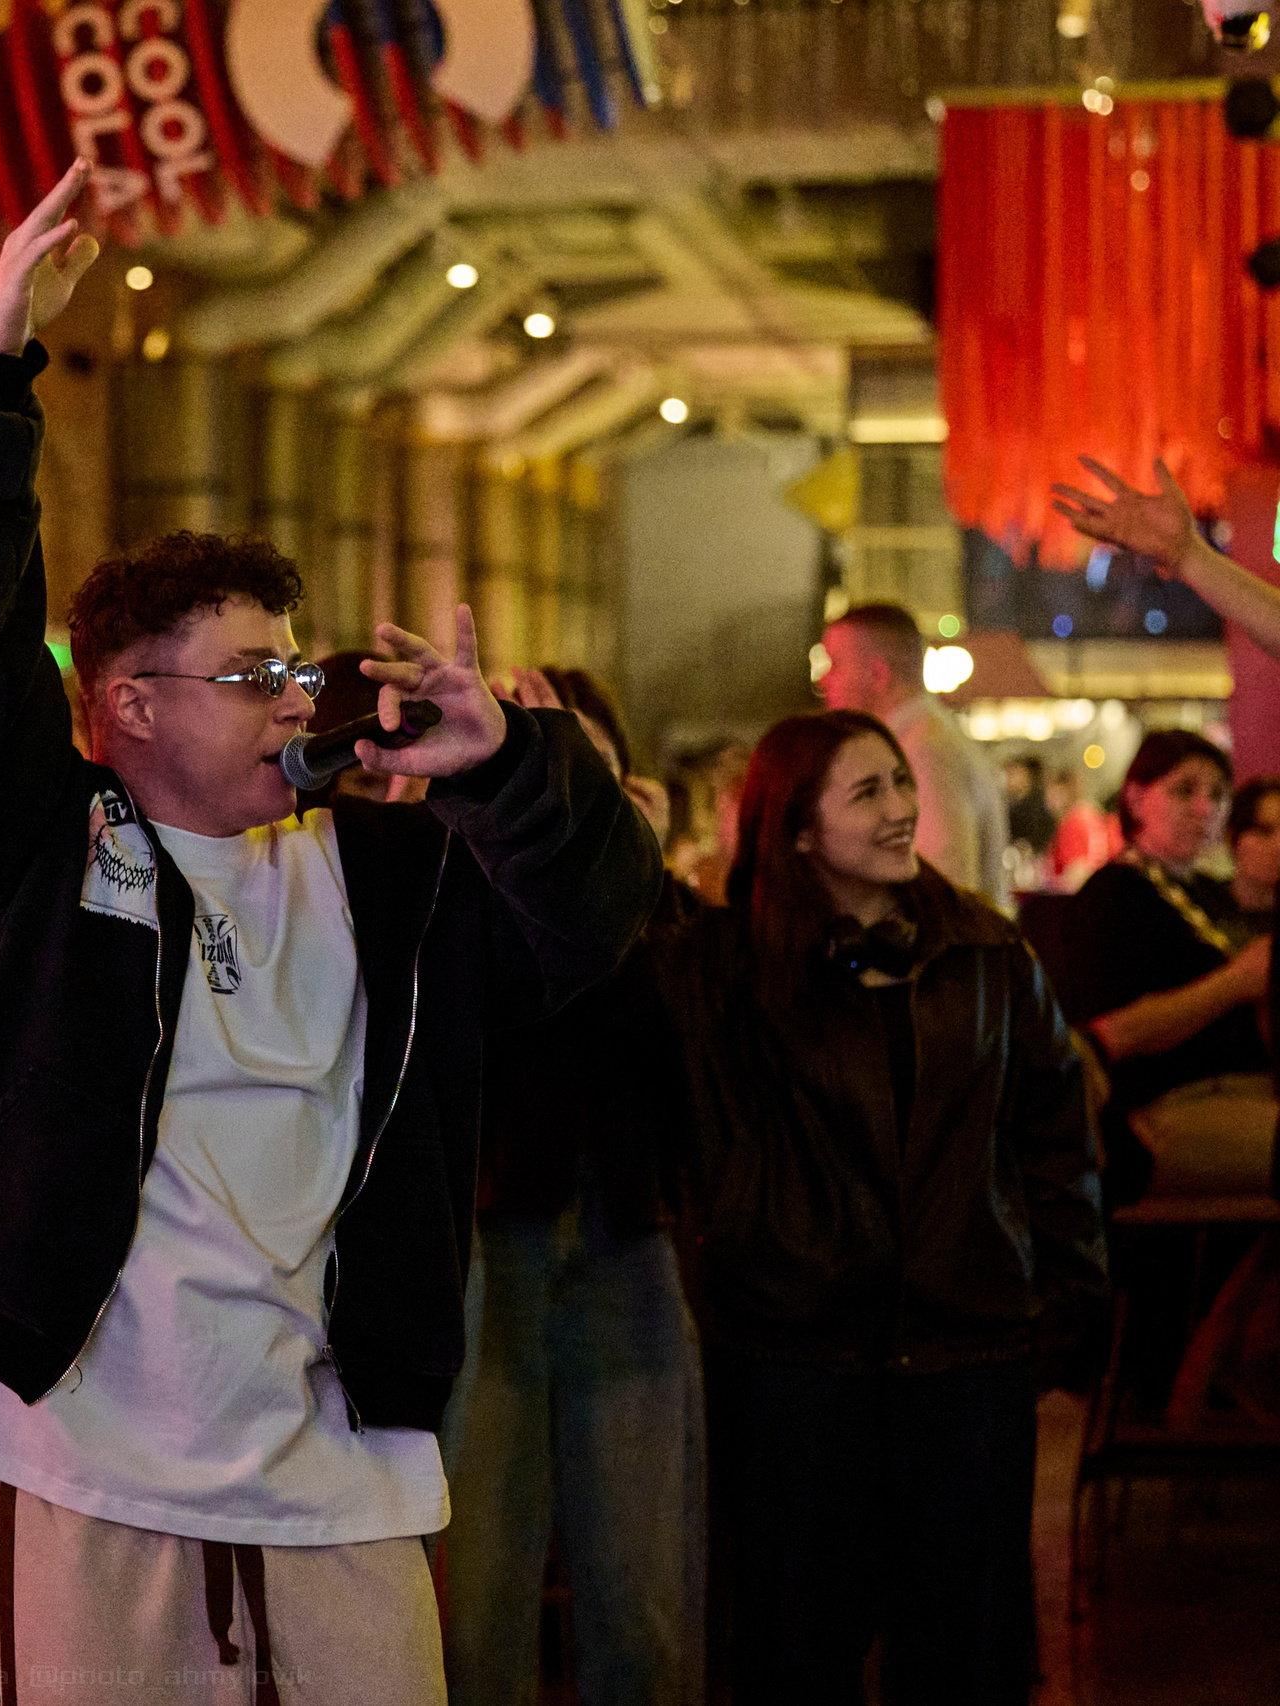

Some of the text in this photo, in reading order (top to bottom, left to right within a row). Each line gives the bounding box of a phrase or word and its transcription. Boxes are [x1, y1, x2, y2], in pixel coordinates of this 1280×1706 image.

[52, 3, 151, 211] COLA
[118, 0, 217, 204] COOL
[197, 934, 237, 970] IZUNA
